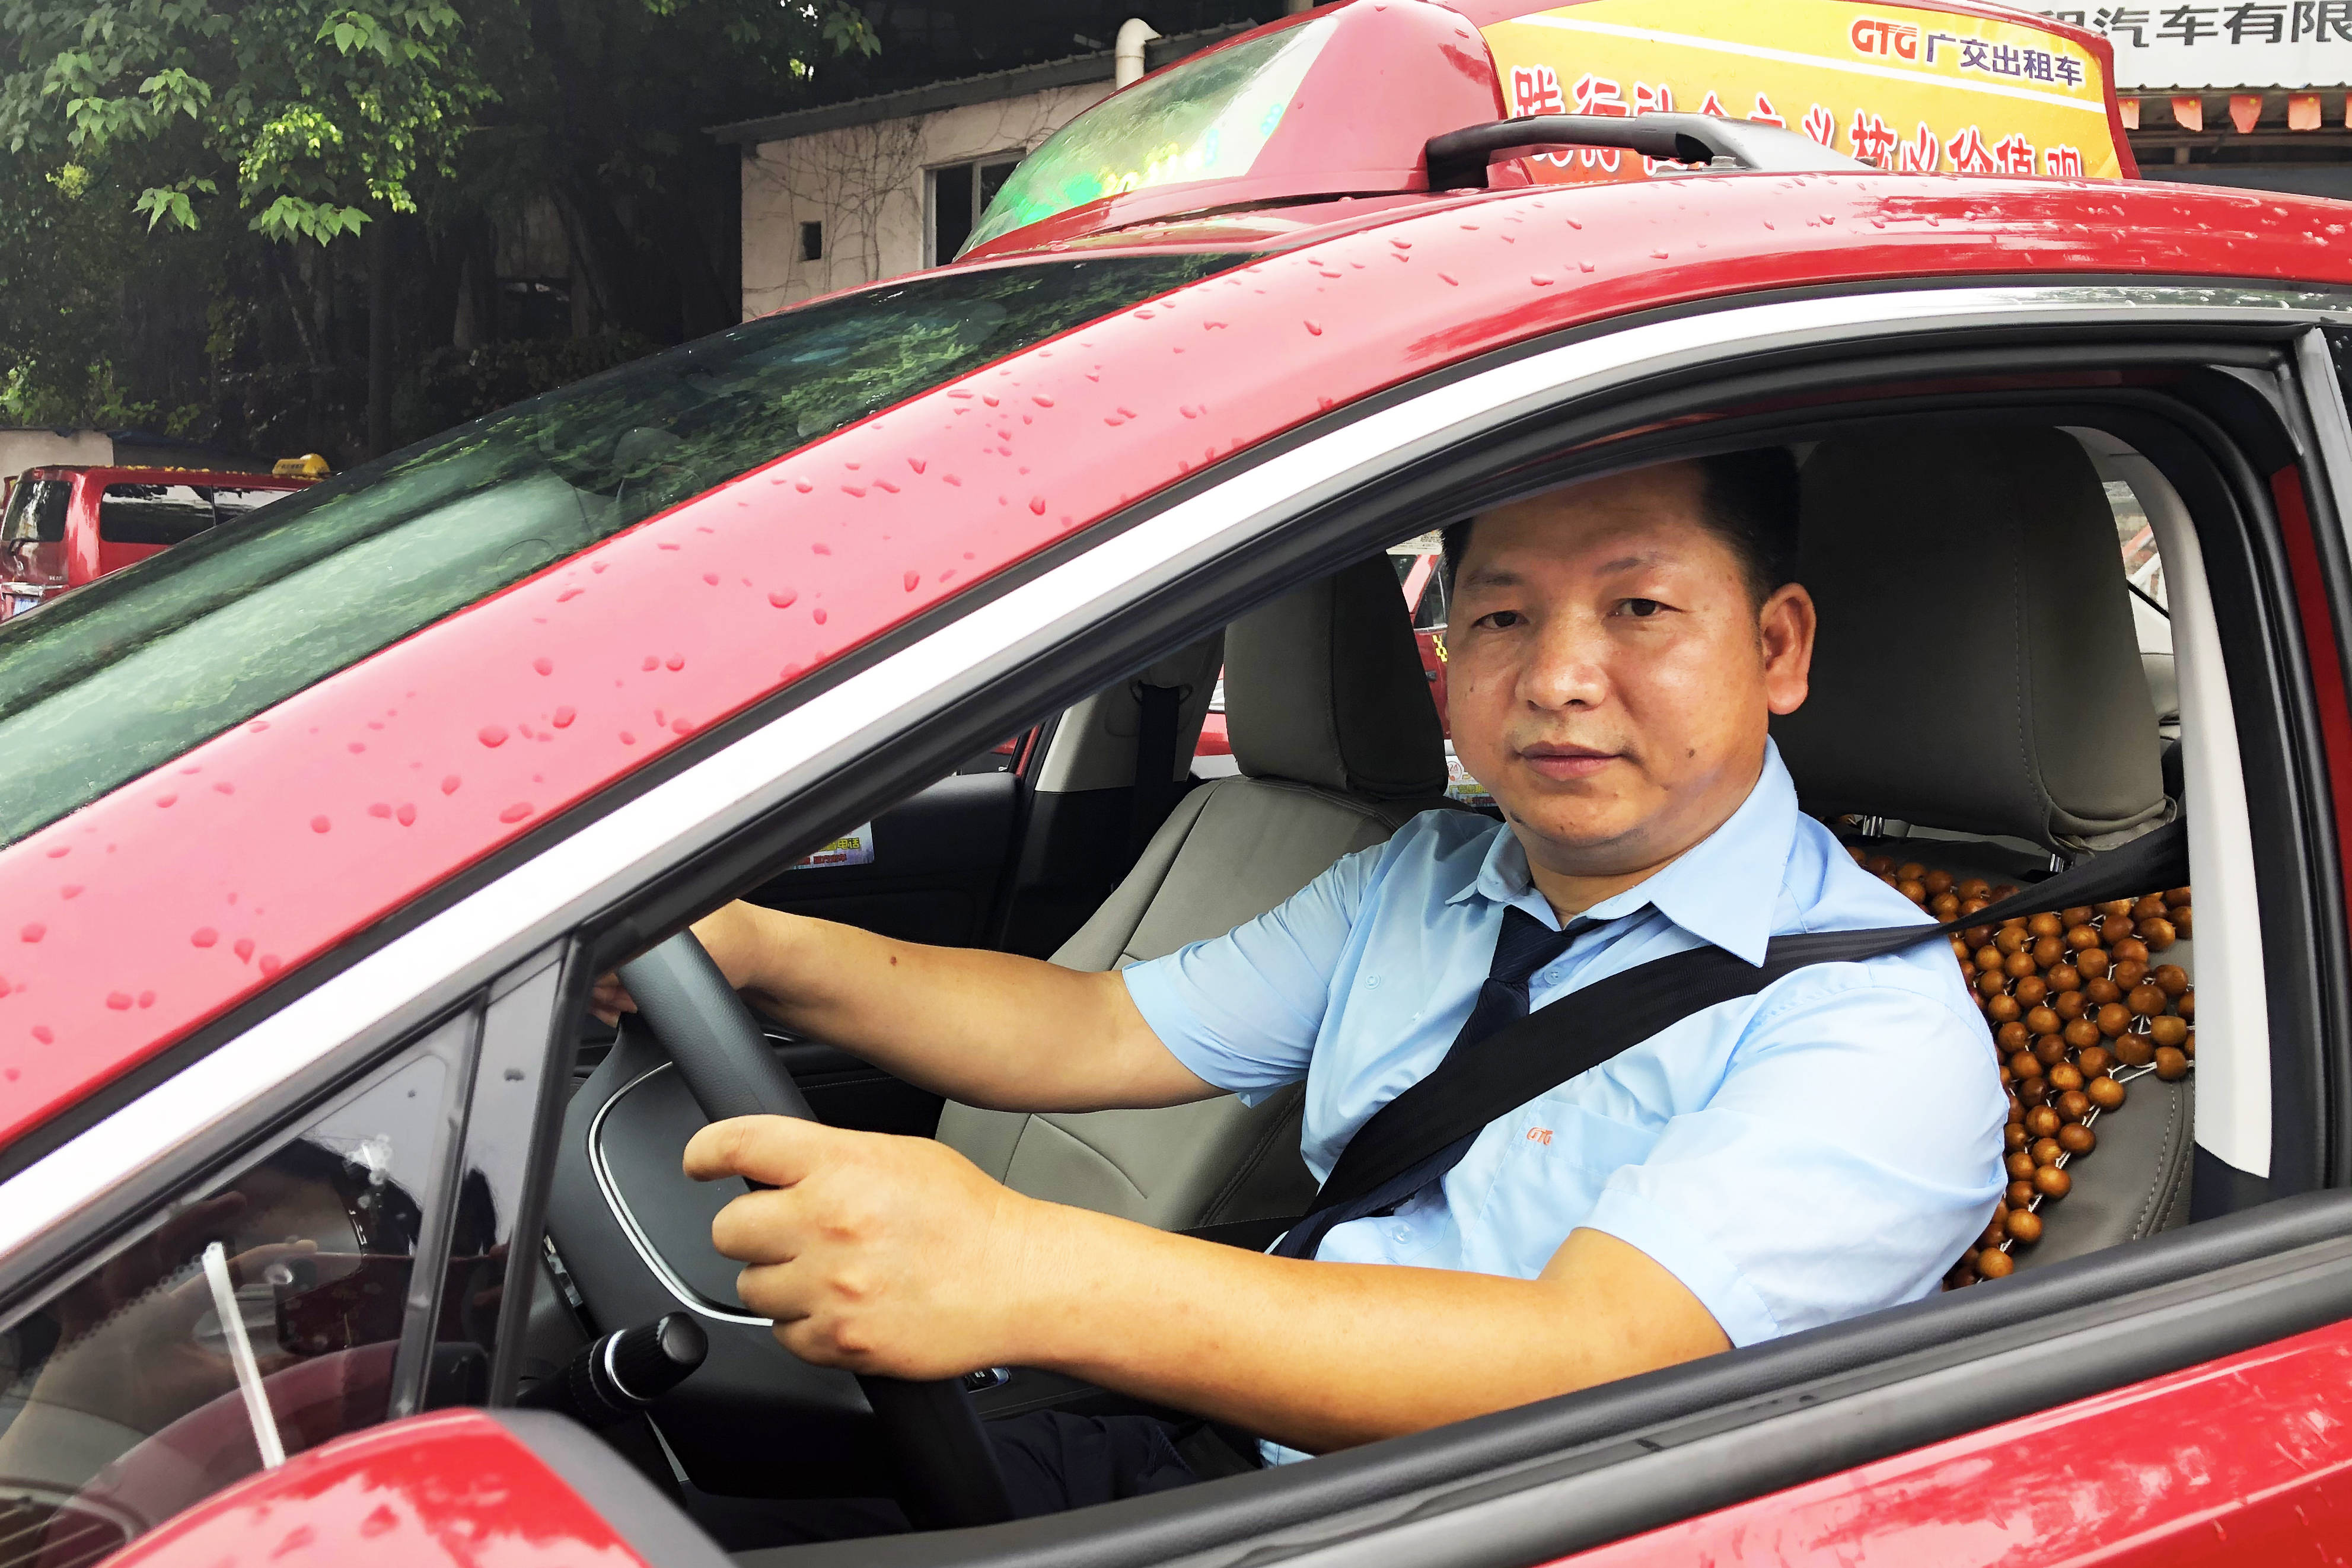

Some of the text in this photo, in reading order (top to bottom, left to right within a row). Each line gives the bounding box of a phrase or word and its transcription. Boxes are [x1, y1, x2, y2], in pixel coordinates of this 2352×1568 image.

[1851, 20, 2083, 87] GTG 广交出租车
